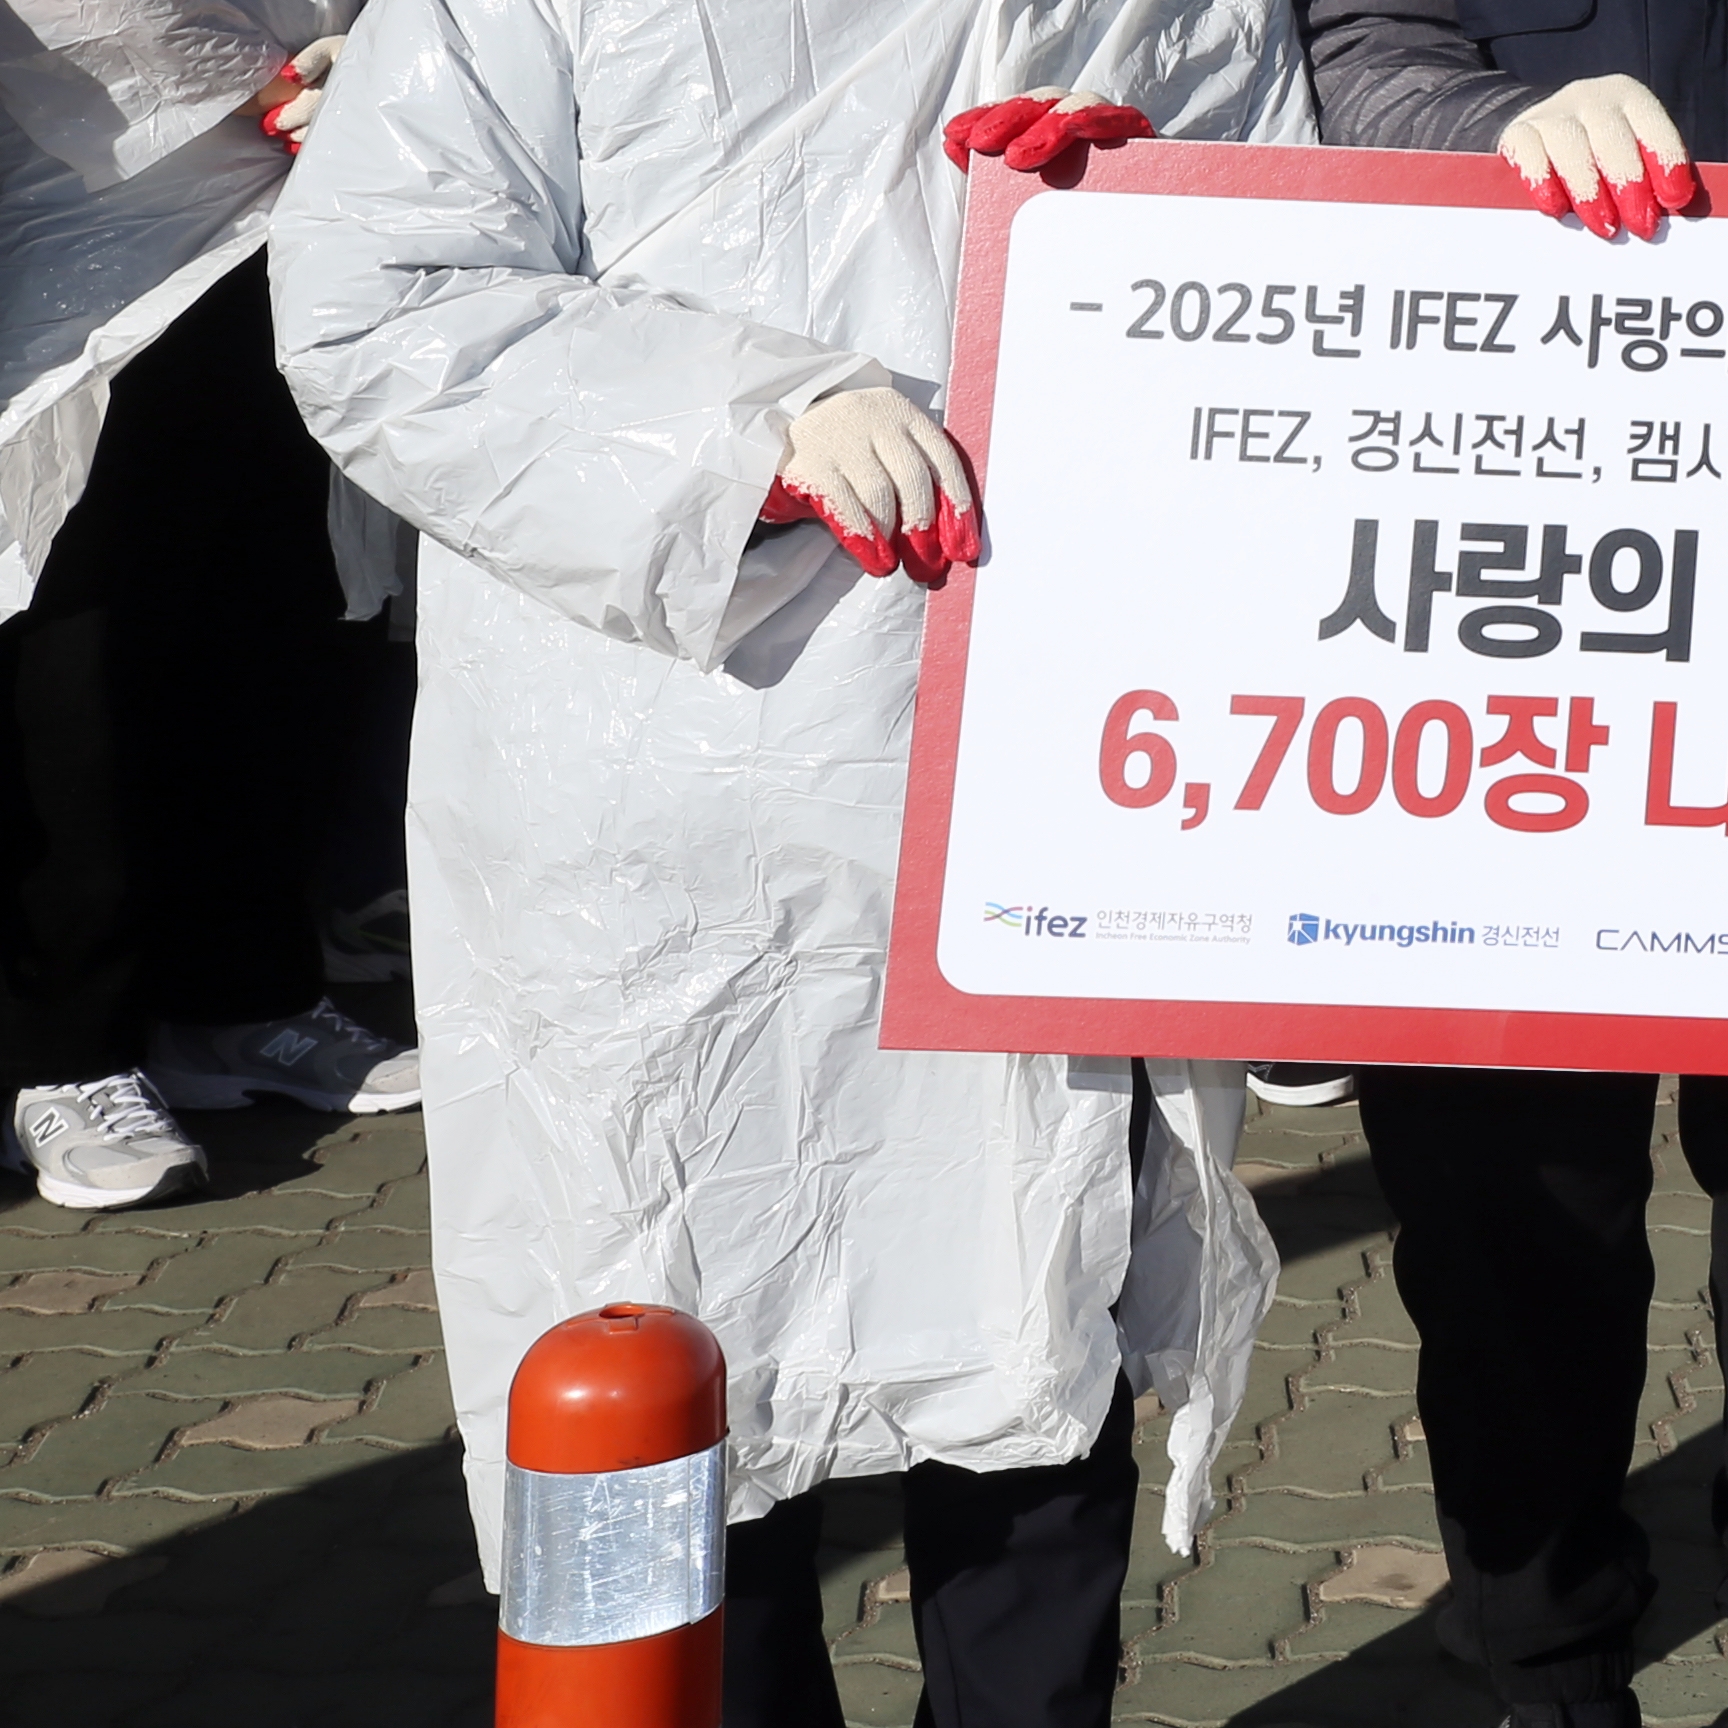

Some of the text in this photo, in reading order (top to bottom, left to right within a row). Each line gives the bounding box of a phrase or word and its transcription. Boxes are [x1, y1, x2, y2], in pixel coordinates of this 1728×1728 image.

[1126, 279, 1365, 359] 2025년
[1389, 289, 1520, 354] IFEZ
[1190, 406, 1323, 473] IFEZ,
[1348, 409, 1602, 484] 경신전선,
[1317, 518, 1700, 664] 사랑의
[1098, 688, 1611, 834] 6,700장
[1024, 906, 1088, 939] ifez
[1096, 909, 1253, 934] 인천경제자유구역청
[1323, 918, 1560, 948] kyungshin 경신전선
[29, 1106, 69, 1149] N
